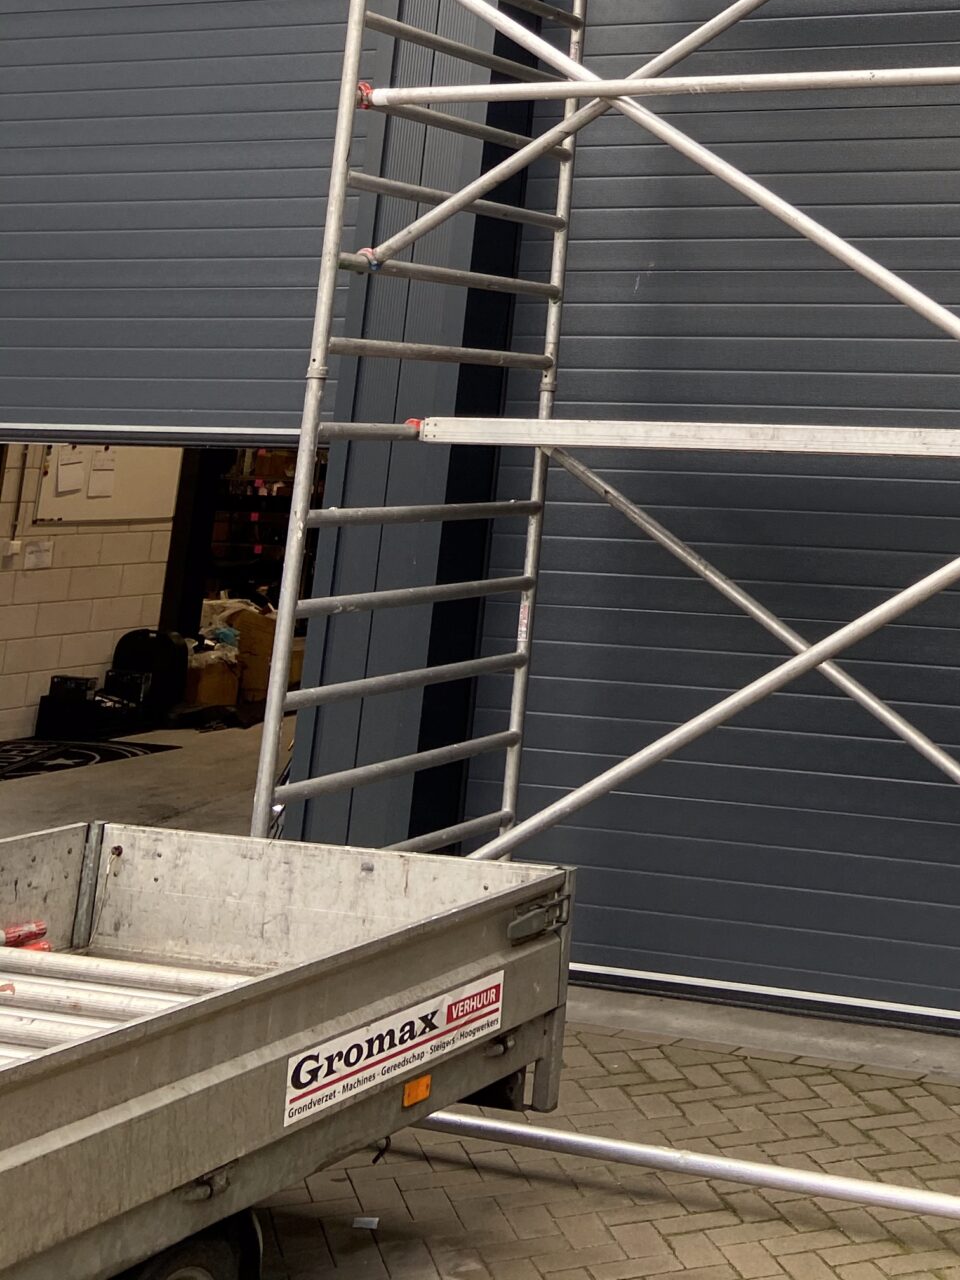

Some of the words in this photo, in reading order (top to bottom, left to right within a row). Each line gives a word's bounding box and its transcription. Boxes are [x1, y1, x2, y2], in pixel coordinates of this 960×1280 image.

[451, 988, 496, 1019] VERHUUR
[288, 1090, 337, 1119] Grondverzet
[341, 1073, 376, 1095] Machines
[381, 1051, 425, 1077] Gereedschap
[429, 1036, 456, 1055] Steigers
[459, 1017, 499, 1039] Hoogwerkers
[290, 1009, 440, 1090] Gromax
